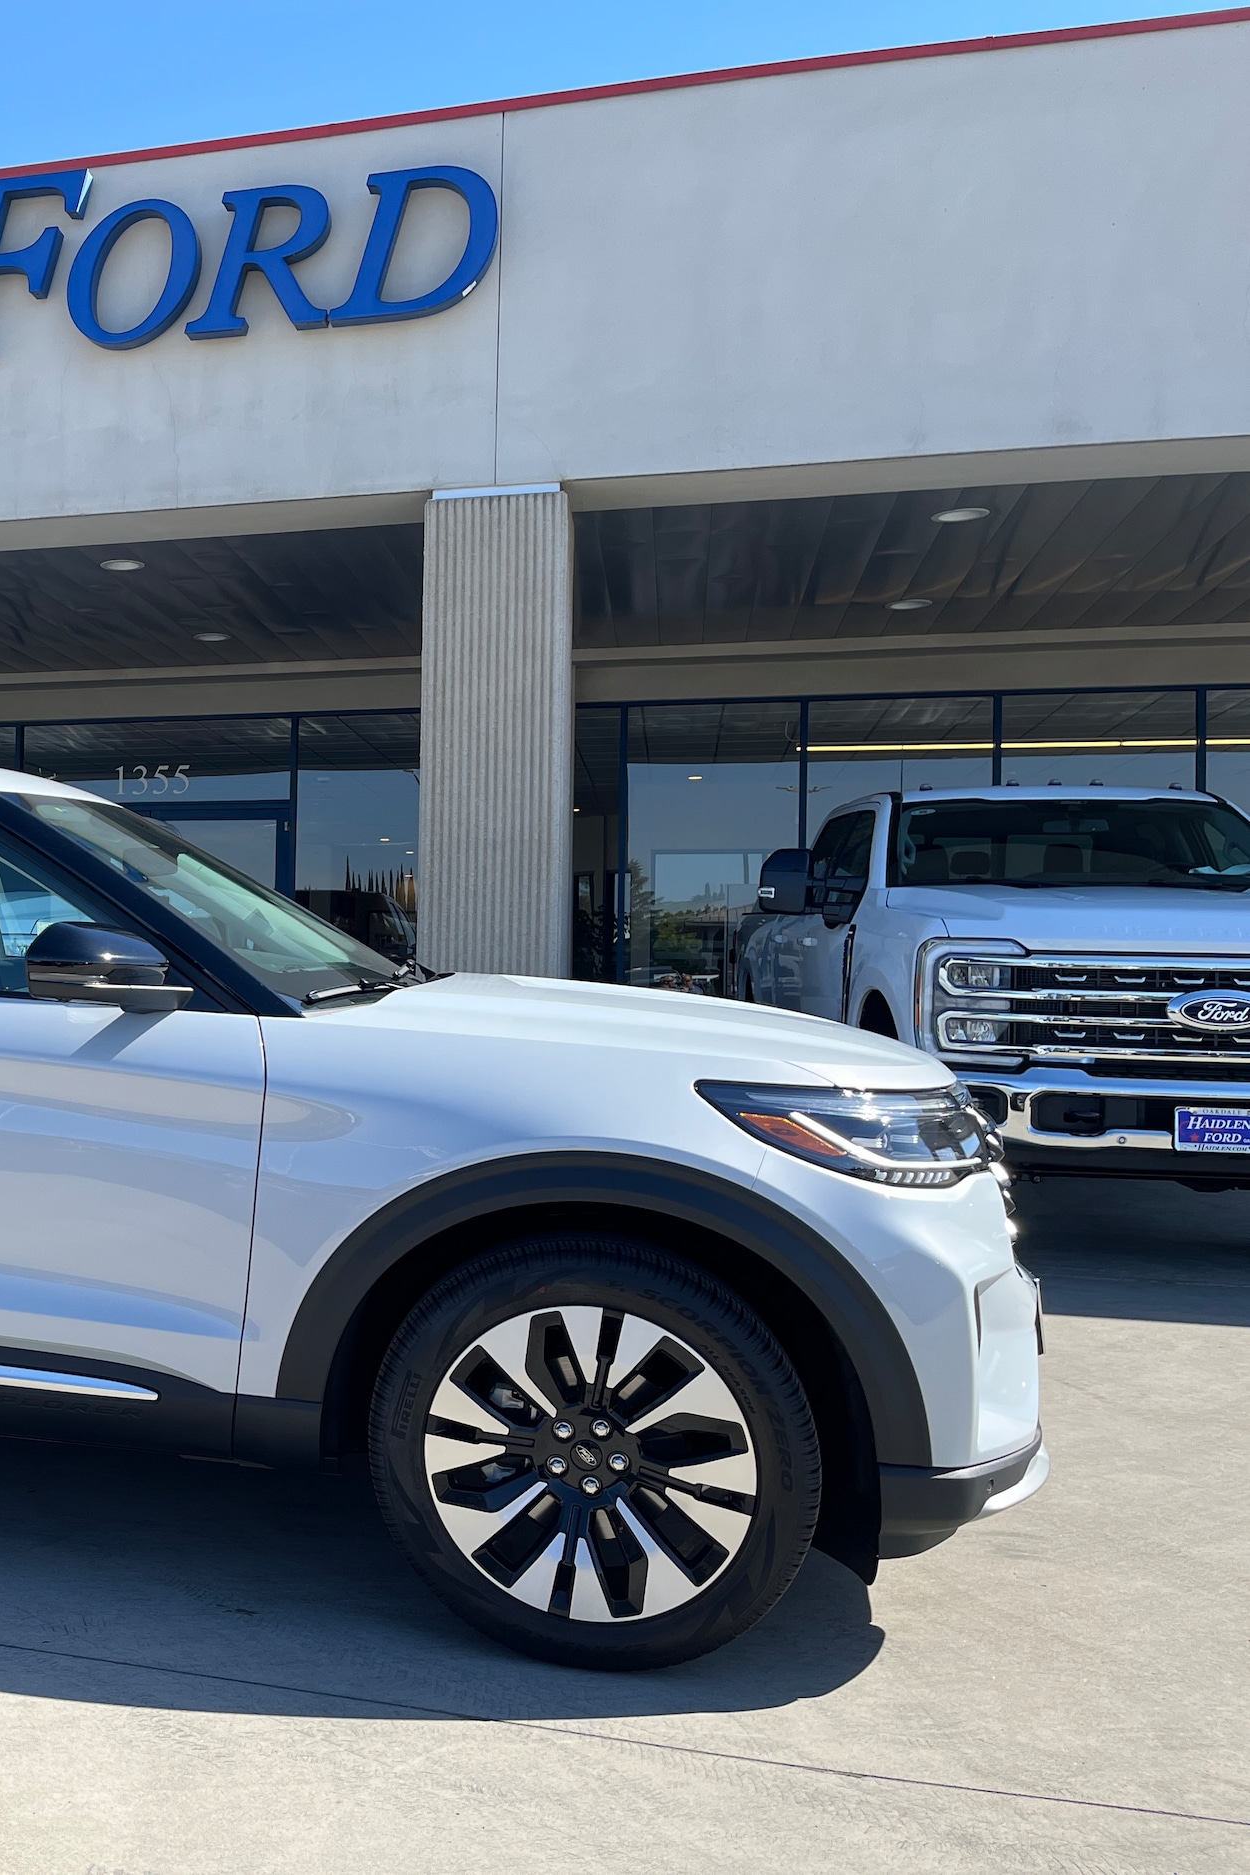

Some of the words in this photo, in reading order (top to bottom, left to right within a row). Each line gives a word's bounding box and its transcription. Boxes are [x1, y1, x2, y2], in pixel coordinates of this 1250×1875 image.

[115, 765, 190, 795] 1355
[1197, 1001, 1249, 1021] Ford
[1187, 1116, 1250, 1130] HAIDLEN
[1203, 1132, 1242, 1143] FORD
[636, 1288, 772, 1399] SCORPION
[764, 1399, 793, 1492] ZERO
[699, 1343, 720, 1361] ALL
[721, 1365, 757, 1414] SEASON
[391, 1369, 422, 1440] PIRELLI
